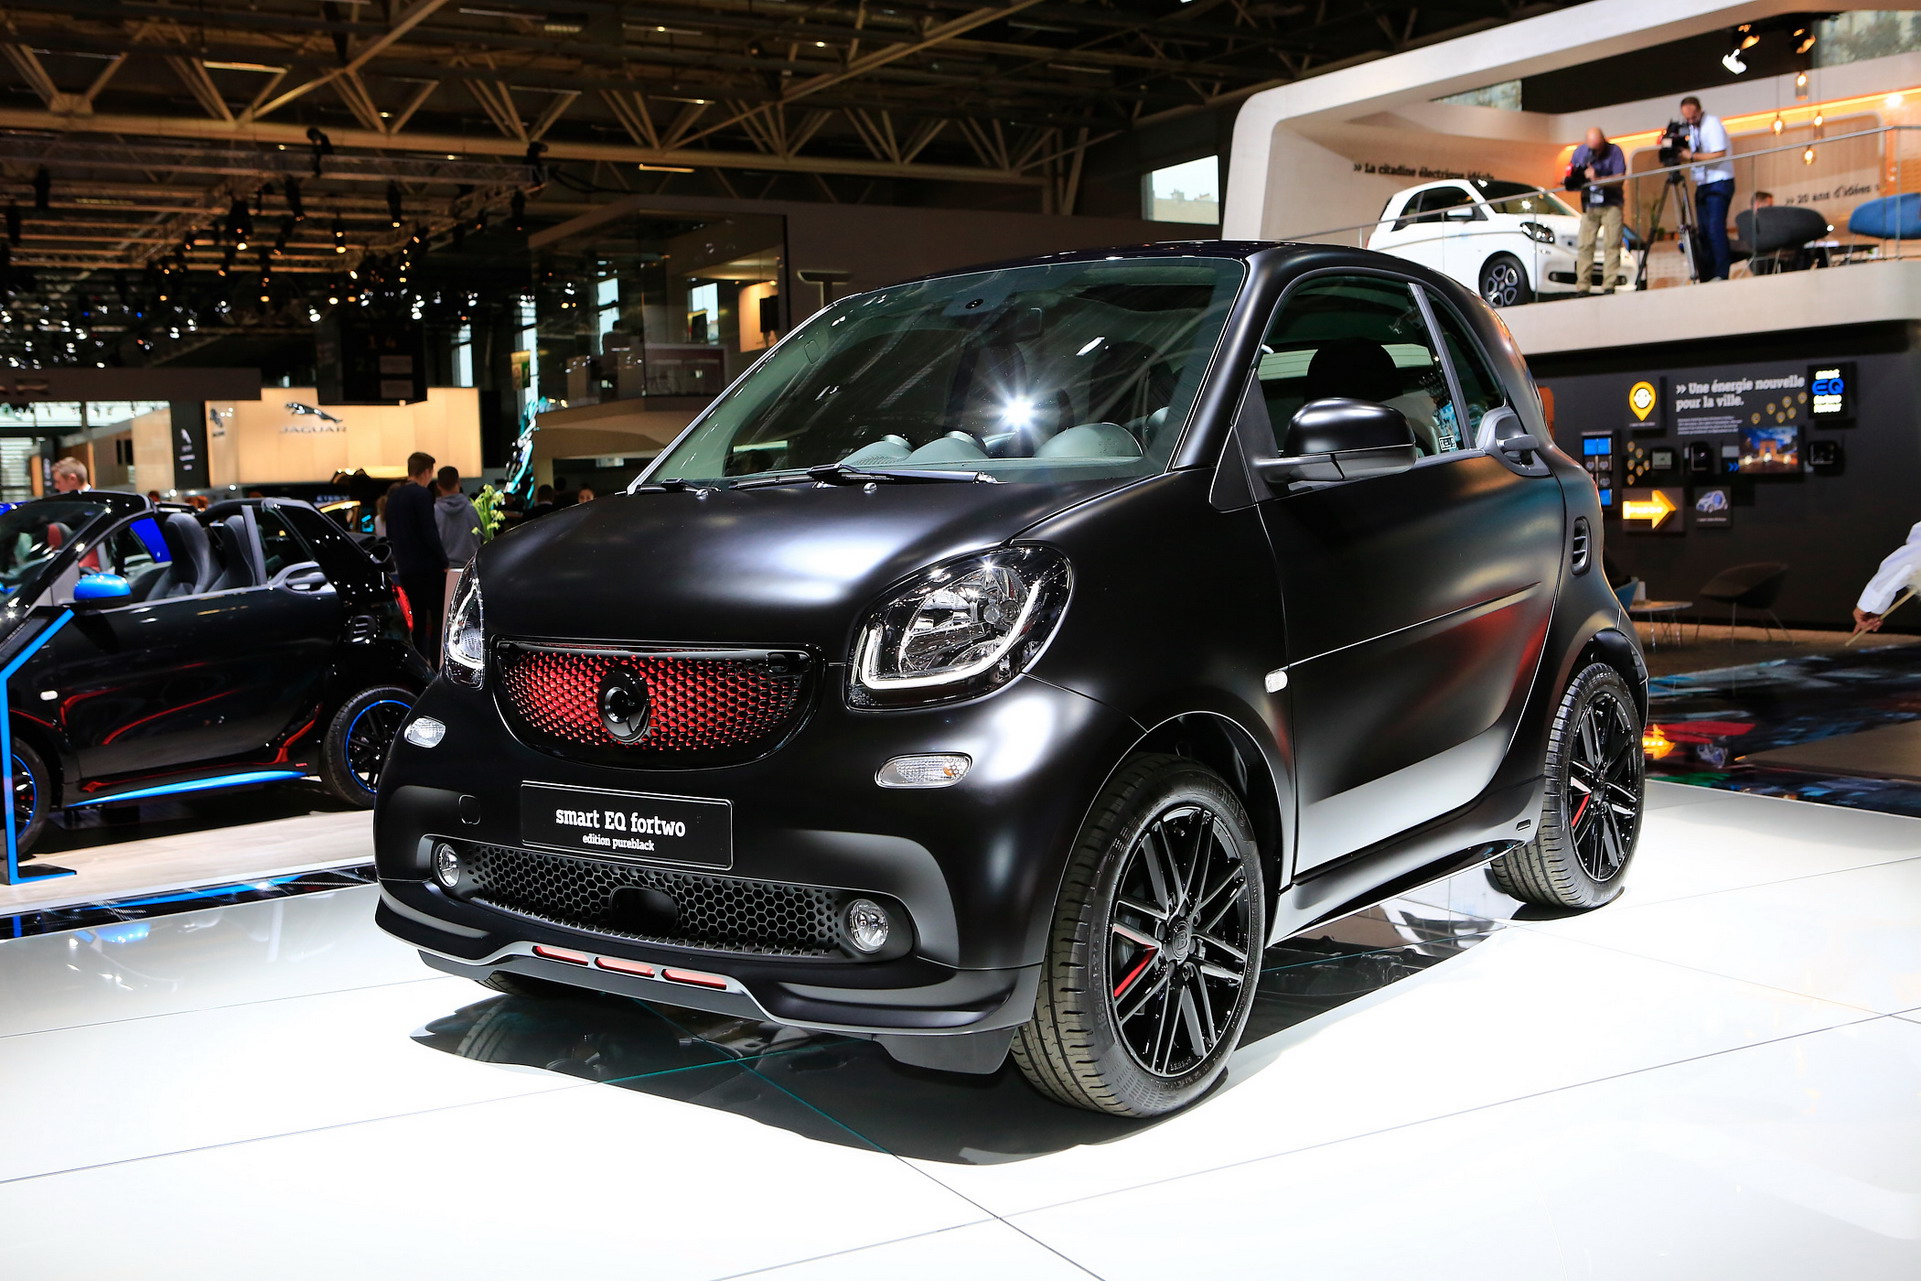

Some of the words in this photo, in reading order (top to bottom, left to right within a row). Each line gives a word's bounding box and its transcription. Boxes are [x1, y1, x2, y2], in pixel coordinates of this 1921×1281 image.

[1688, 382, 1710, 395] Une
[1711, 377, 1754, 397] énergie
[1754, 374, 1805, 391] nouvelle
[1811, 378, 1844, 396] EQ
[1675, 398, 1702, 412] pour
[1703, 395, 1714, 408] la
[279, 425, 347, 434] JAGUAR
[555, 808, 600, 828] smart
[604, 811, 626, 832] EQ
[630, 812, 686, 837] fortwo
[582, 833, 611, 847] edition
[612, 836, 655, 851] pureblack
